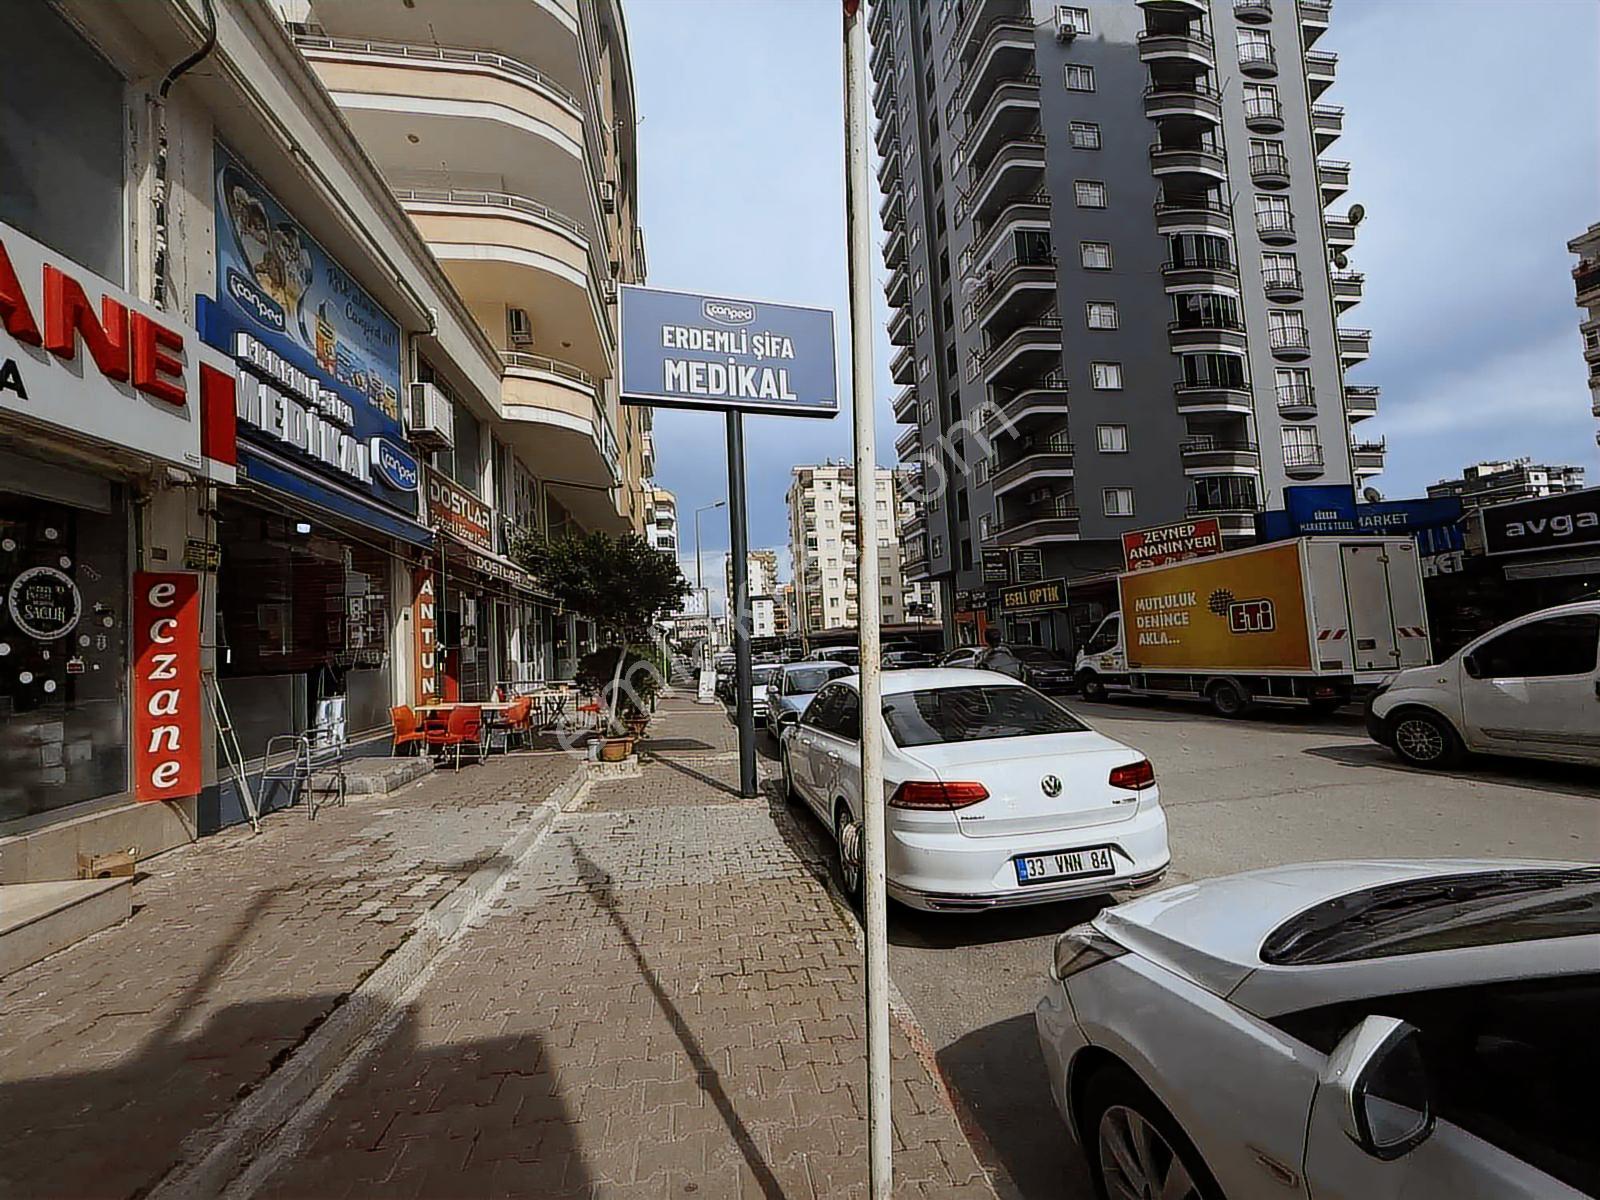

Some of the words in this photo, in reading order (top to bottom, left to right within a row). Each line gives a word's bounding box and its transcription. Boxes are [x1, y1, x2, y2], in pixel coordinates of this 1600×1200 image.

[662, 325, 747, 355] ERDEMLİ
[752, 331, 795, 361] ŞİFA
[663, 357, 798, 401] MEDİKAL
[236, 368, 373, 485] MEDİKAL
[430, 477, 491, 532] DOSTLAR
[1129, 540, 1183, 560] ANANIN
[1184, 531, 1217, 550] YERİ
[1143, 525, 1196, 544] ZEYNEP
[1029, 583, 1060, 604] OPTİK
[1135, 592, 1198, 612] MUTLULUK
[1136, 610, 1190, 629] DENİNCE
[149, 582, 181, 789] eczane
[1027, 856, 1046, 877] 33
[1090, 851, 1109, 869] 84
